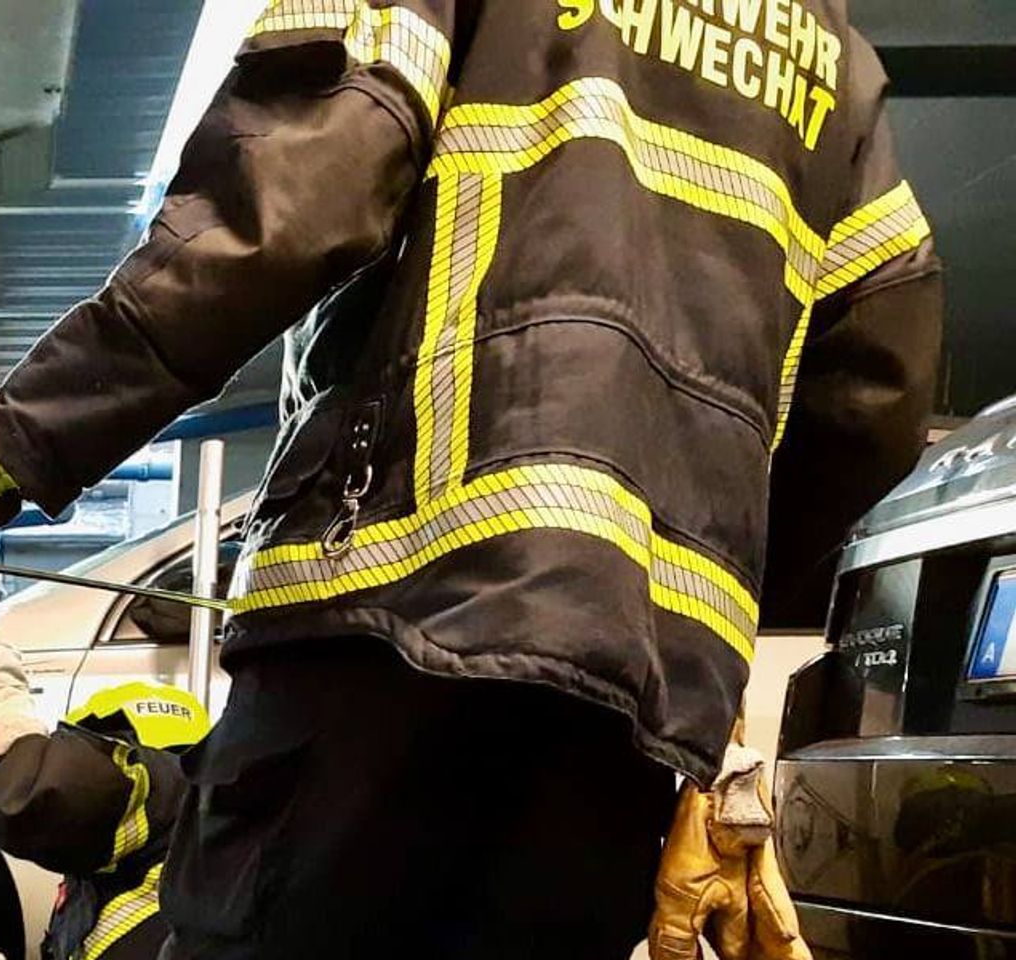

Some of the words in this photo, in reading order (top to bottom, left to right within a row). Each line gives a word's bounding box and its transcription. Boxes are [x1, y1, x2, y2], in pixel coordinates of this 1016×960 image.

[687, 0, 841, 90] WEHR
[981, 641, 996, 664] A
[136, 701, 192, 720] FEUER
